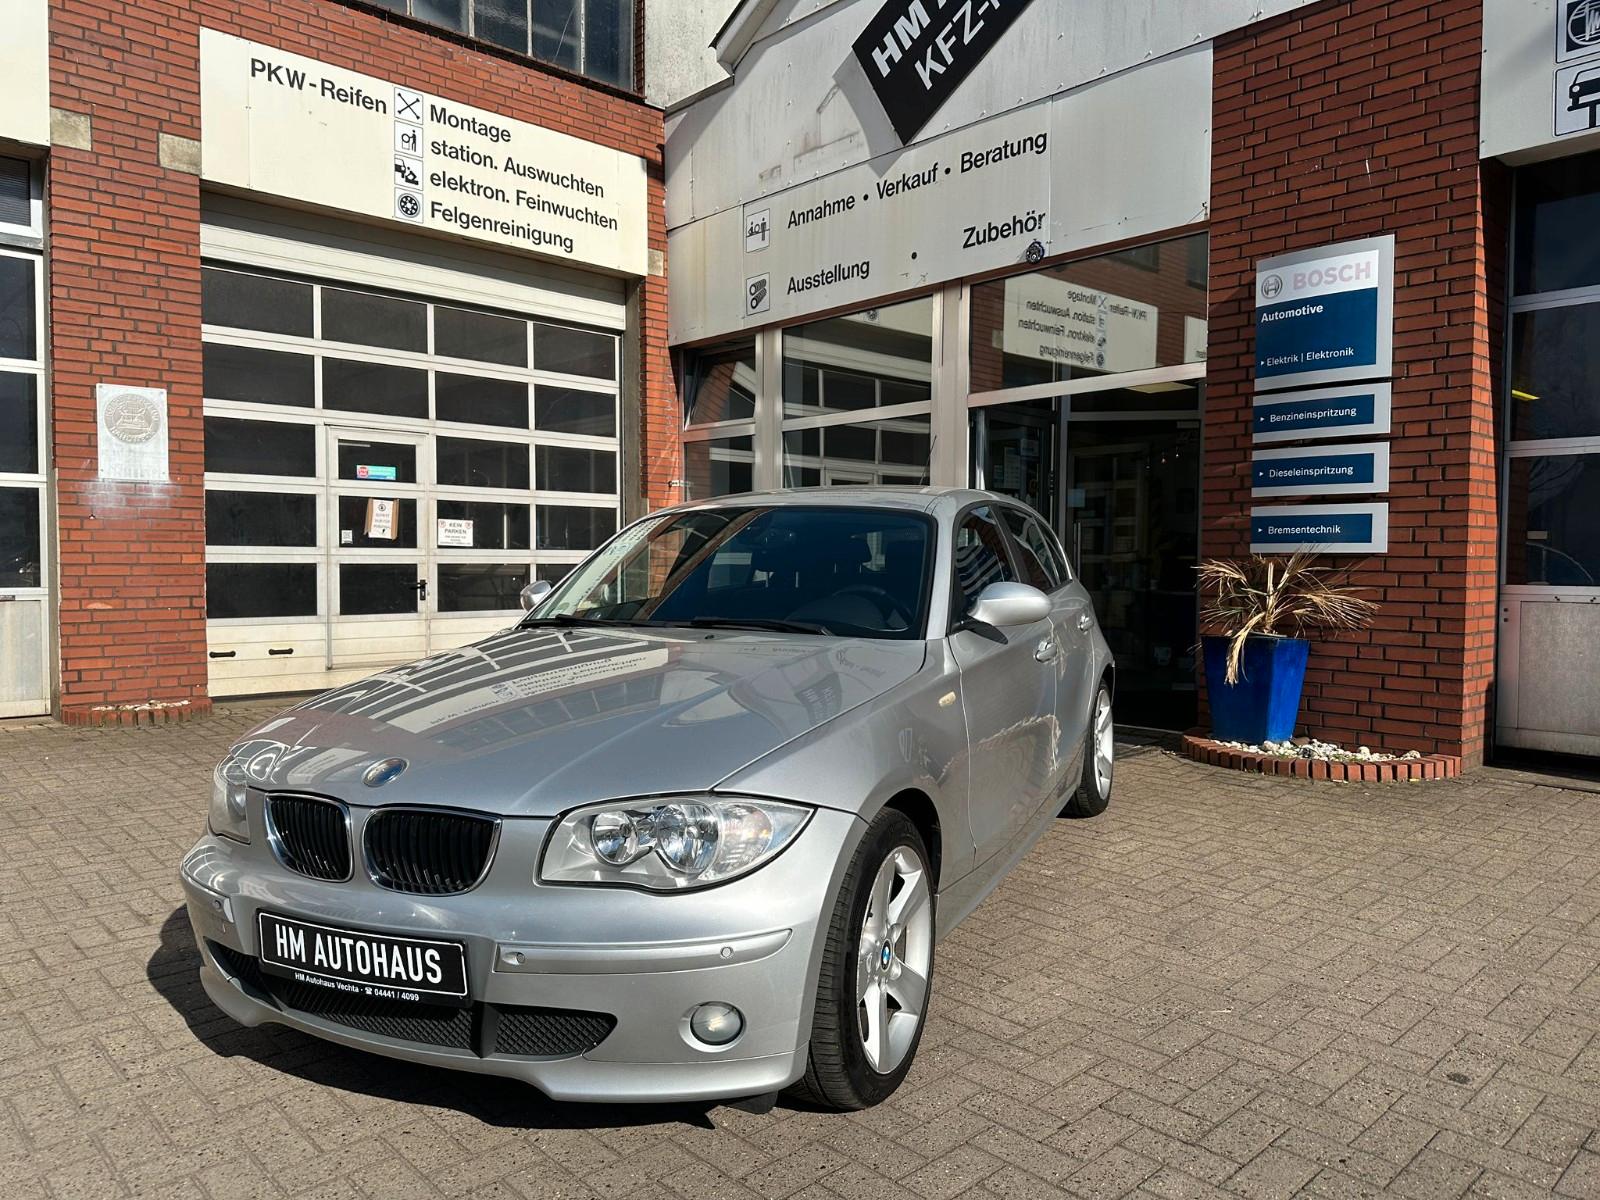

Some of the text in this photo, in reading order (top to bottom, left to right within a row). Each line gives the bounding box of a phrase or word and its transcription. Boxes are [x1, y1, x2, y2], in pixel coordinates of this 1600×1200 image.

[871, 0, 932, 78] HM
[914, 0, 1001, 91] KFZ-
[250, 57, 387, 114] PKW-Reifen
[430, 104, 511, 143] Montage
[430, 140, 604, 198] station. Auswuchten
[787, 132, 1048, 229] Annahme Verkauf Beratung
[429, 171, 618, 231] elektron. Feinwuchten
[430, 201, 574, 253] Felgenreinigung
[787, 210, 1046, 296] Ausstellung Zubehör
[1293, 260, 1371, 290] BOSCH
[1260, 304, 1324, 323] Automotive
[1266, 354, 1299, 367] Elektrik
[1306, 346, 1354, 361] Elektronik
[1269, 407, 1357, 423] Benzineinspritzung
[1268, 465, 1354, 479] Dieseleinspritzung
[1267, 524, 1341, 535] Bremsentechnik
[275, 923, 442, 985] HM AUTOHAUS
[294, 972, 305, 981] HM
[305, 975, 336, 988] Autohaus
[336, 982, 360, 993] Vechta
[374, 988, 395, 999] 04441
[401, 992, 420, 1001] 4099
